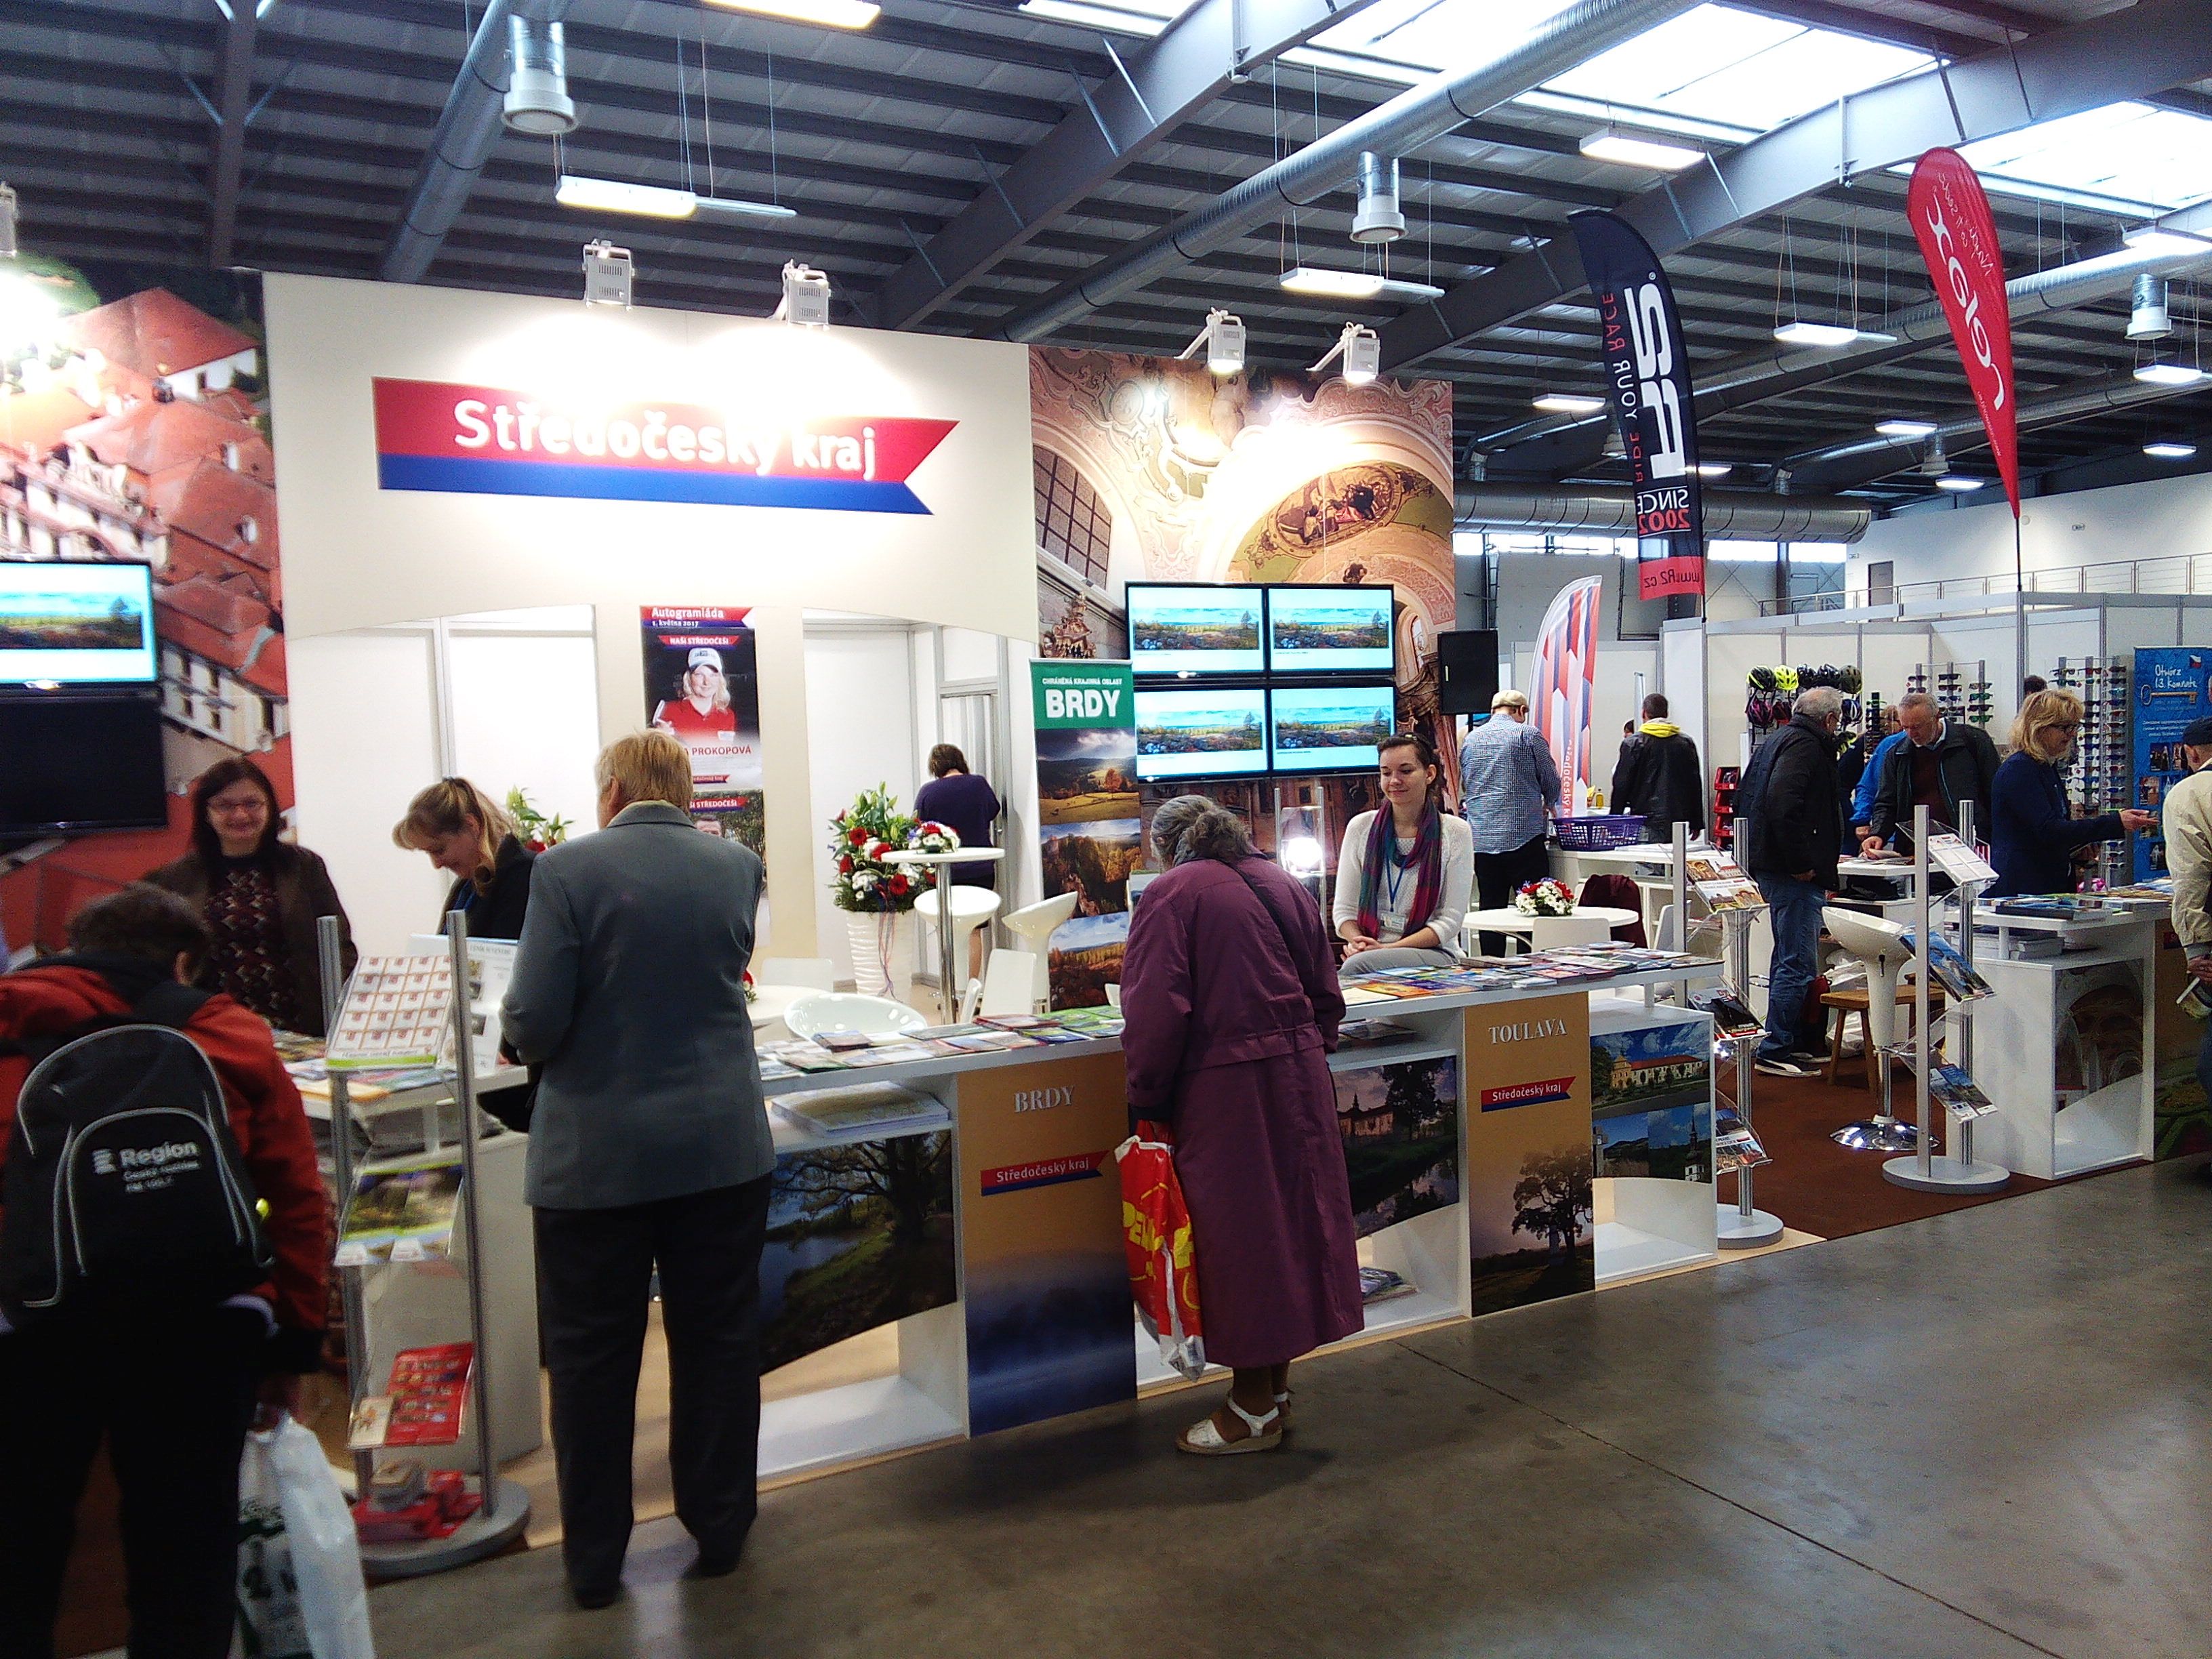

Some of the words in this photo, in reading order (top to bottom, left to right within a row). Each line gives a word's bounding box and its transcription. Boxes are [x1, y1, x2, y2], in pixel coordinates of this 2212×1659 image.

[453, 398, 783, 476] Středočeský
[790, 426, 876, 481] kraj
[670, 636, 687, 644] NAŠI
[1045, 689, 1121, 718] BRDY
[692, 744, 752, 756] PROKOPOVÁ
[696, 800, 738, 808] STŘEDOČEŠI
[1488, 1017, 1568, 1045] TOULAVA
[1014, 1085, 1076, 1113] BRDY
[1492, 1084, 1544, 1102] Středočeský
[1544, 1082, 1561, 1094] kraj
[119, 1141, 199, 1168] Region
[996, 1161, 1066, 1183] Středočeský
[1068, 1157, 1089, 1171] kraj
